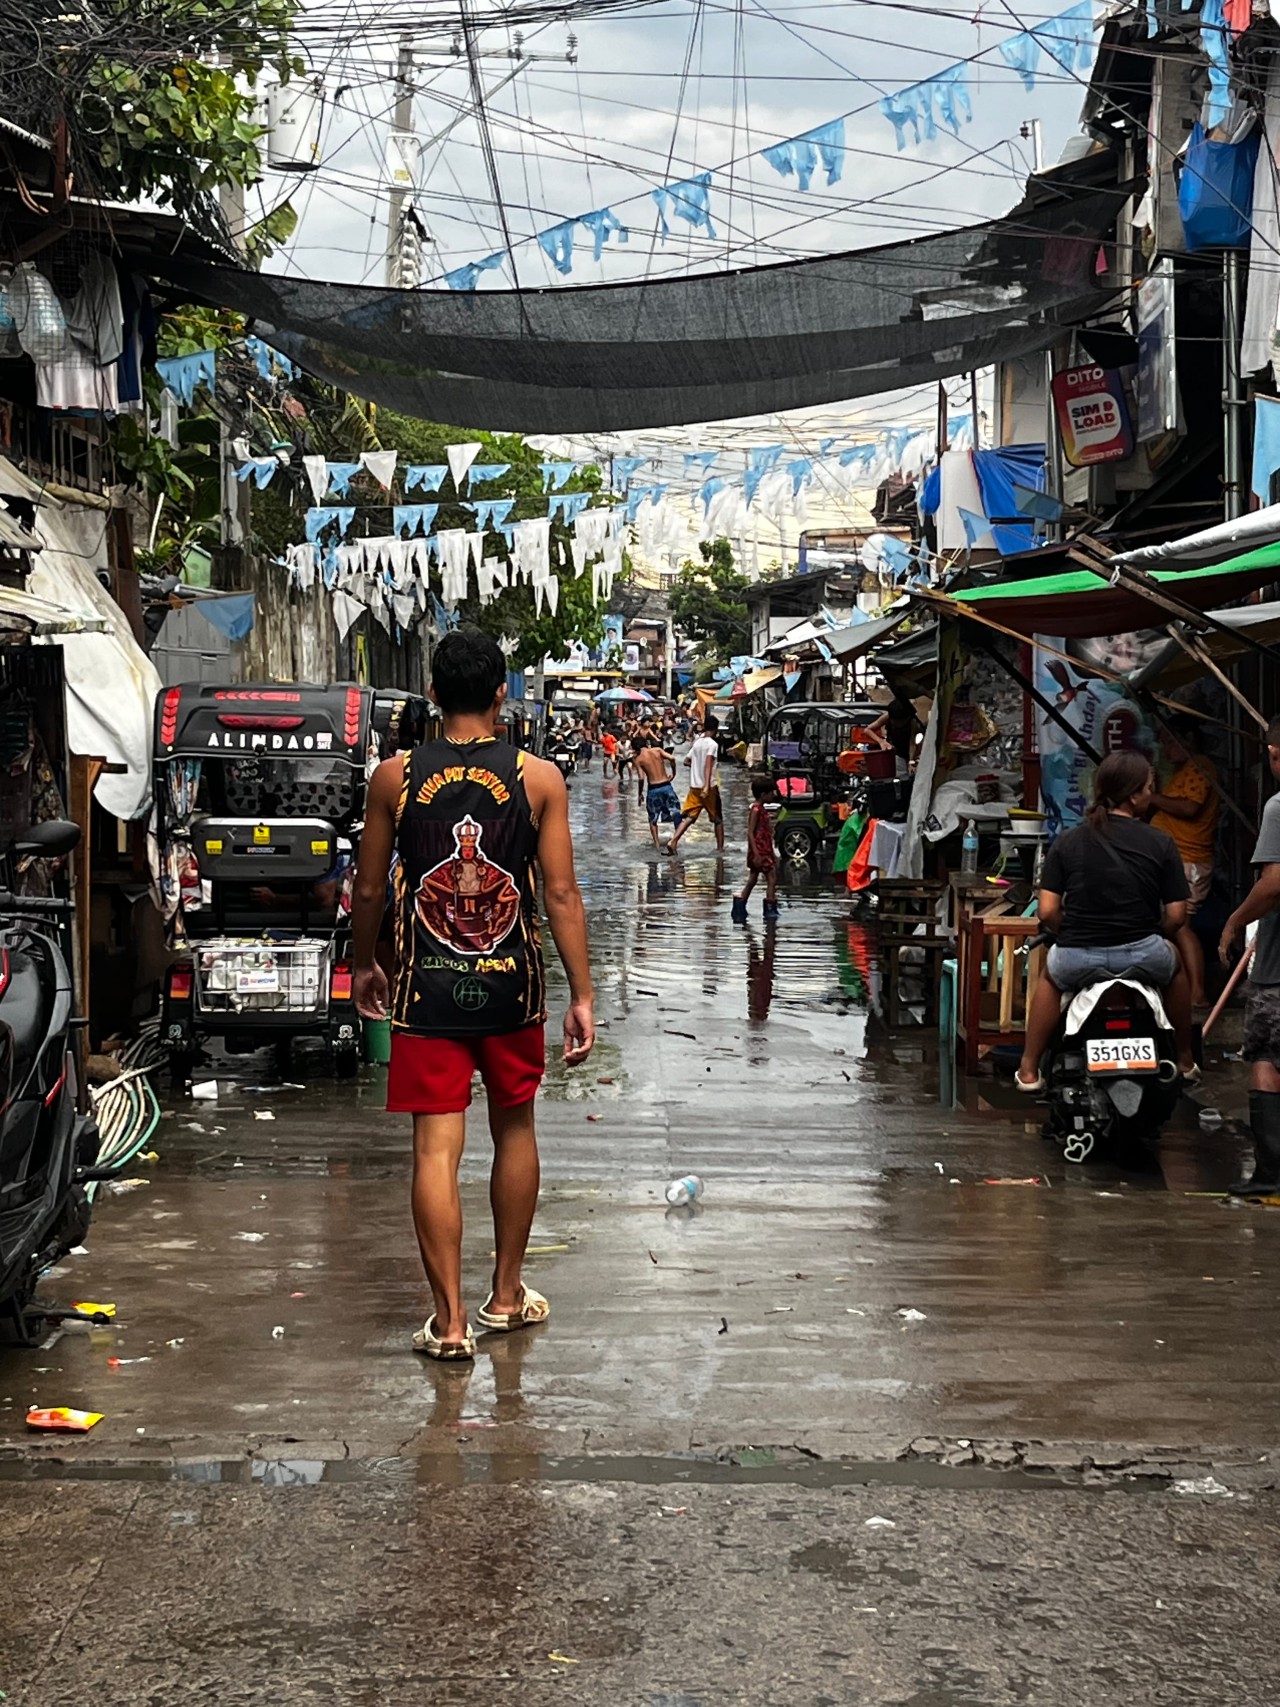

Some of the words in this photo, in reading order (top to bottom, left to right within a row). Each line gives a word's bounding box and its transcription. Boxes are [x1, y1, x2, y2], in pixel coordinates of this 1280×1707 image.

[1067, 368, 1104, 385] DITO
[1072, 403, 1100, 418] SIM
[1074, 413, 1116, 430] LOAD
[207, 732, 314, 750] ALINDAO
[466, 766, 510, 805] SENYOR
[1091, 1045, 1152, 1062] 351GXS
